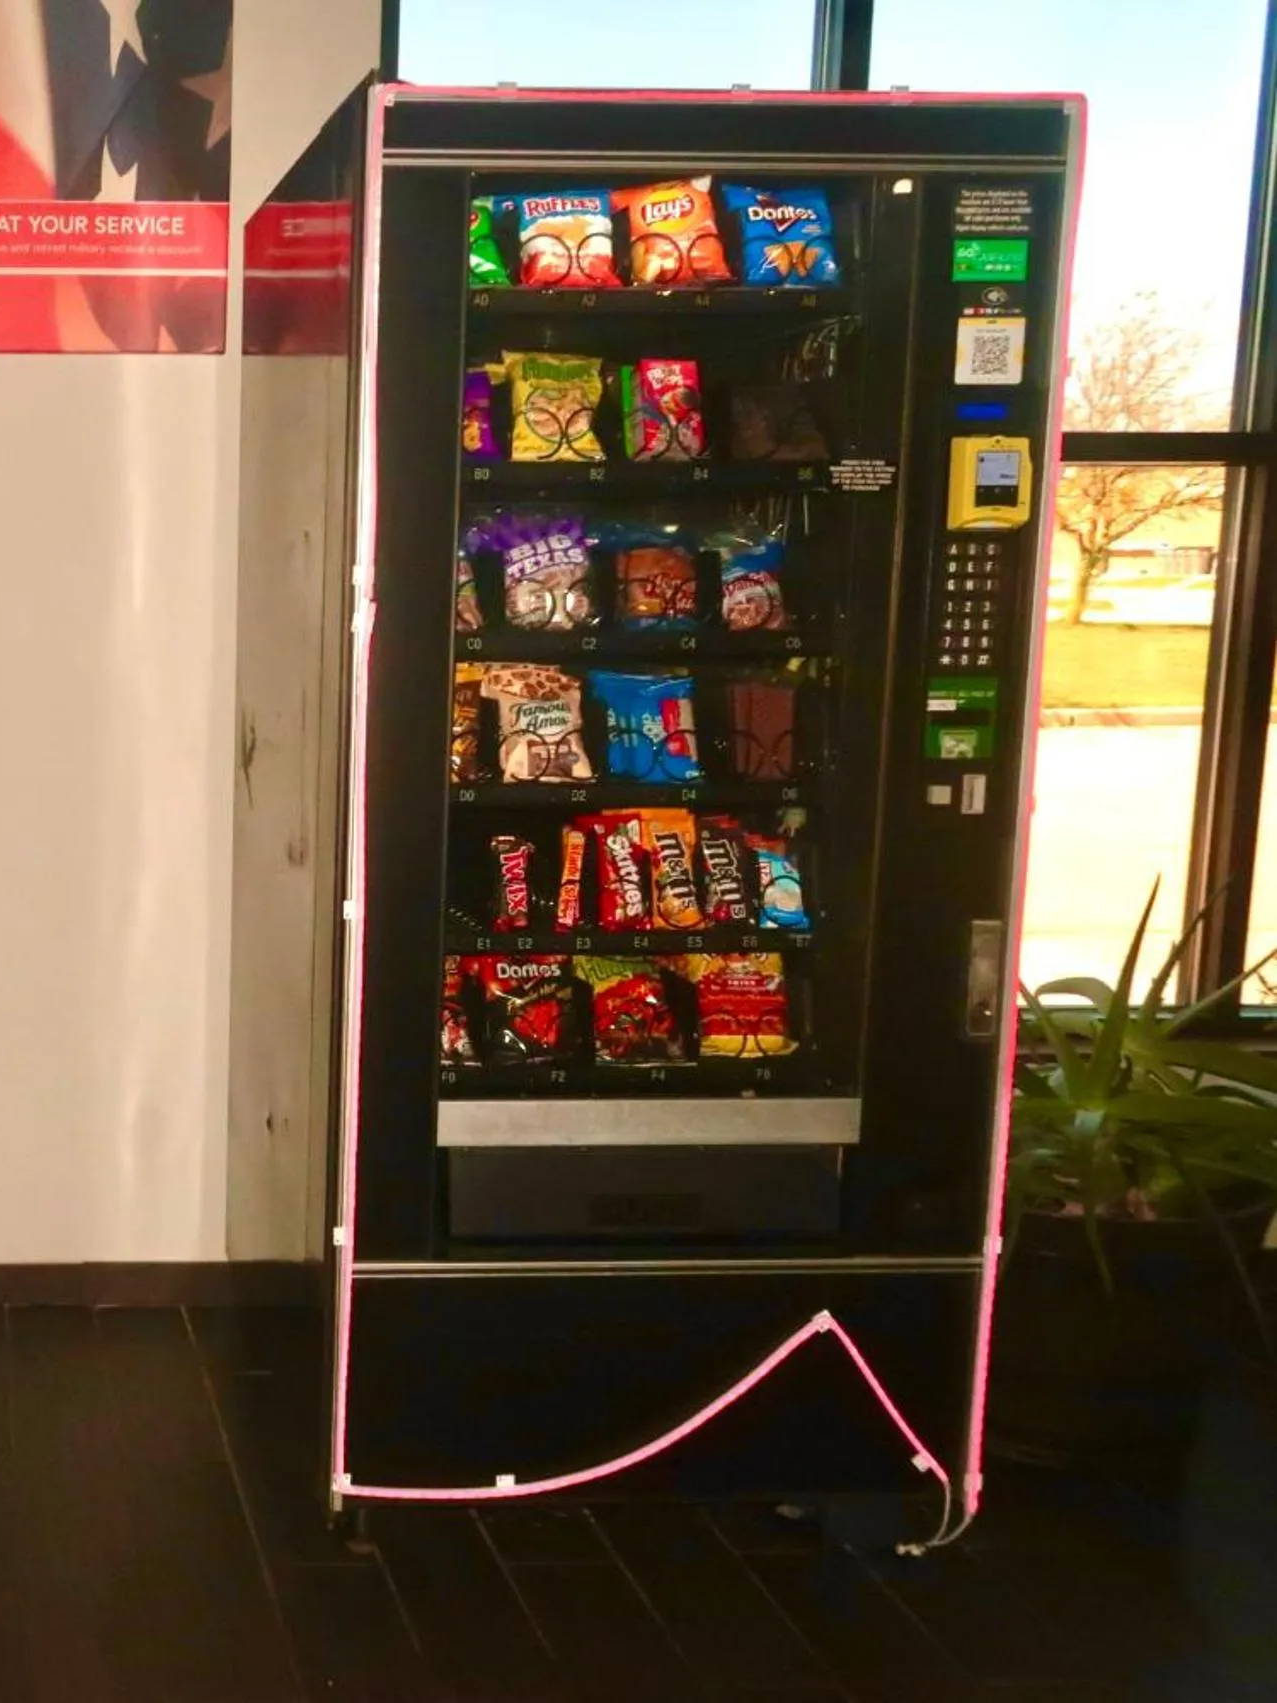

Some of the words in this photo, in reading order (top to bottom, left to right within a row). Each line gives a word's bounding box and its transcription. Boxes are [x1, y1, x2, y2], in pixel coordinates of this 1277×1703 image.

[748, 205, 818, 221] Doritos
[28, 215, 88, 234] YOUR
[95, 215, 185, 235] SERVICE
[510, 534, 572, 559] BIG
[506, 547, 585, 579] TEXAS
[526, 715, 569, 731] Amos
[518, 937, 533, 949] E2
[496, 963, 561, 979] Doritos
